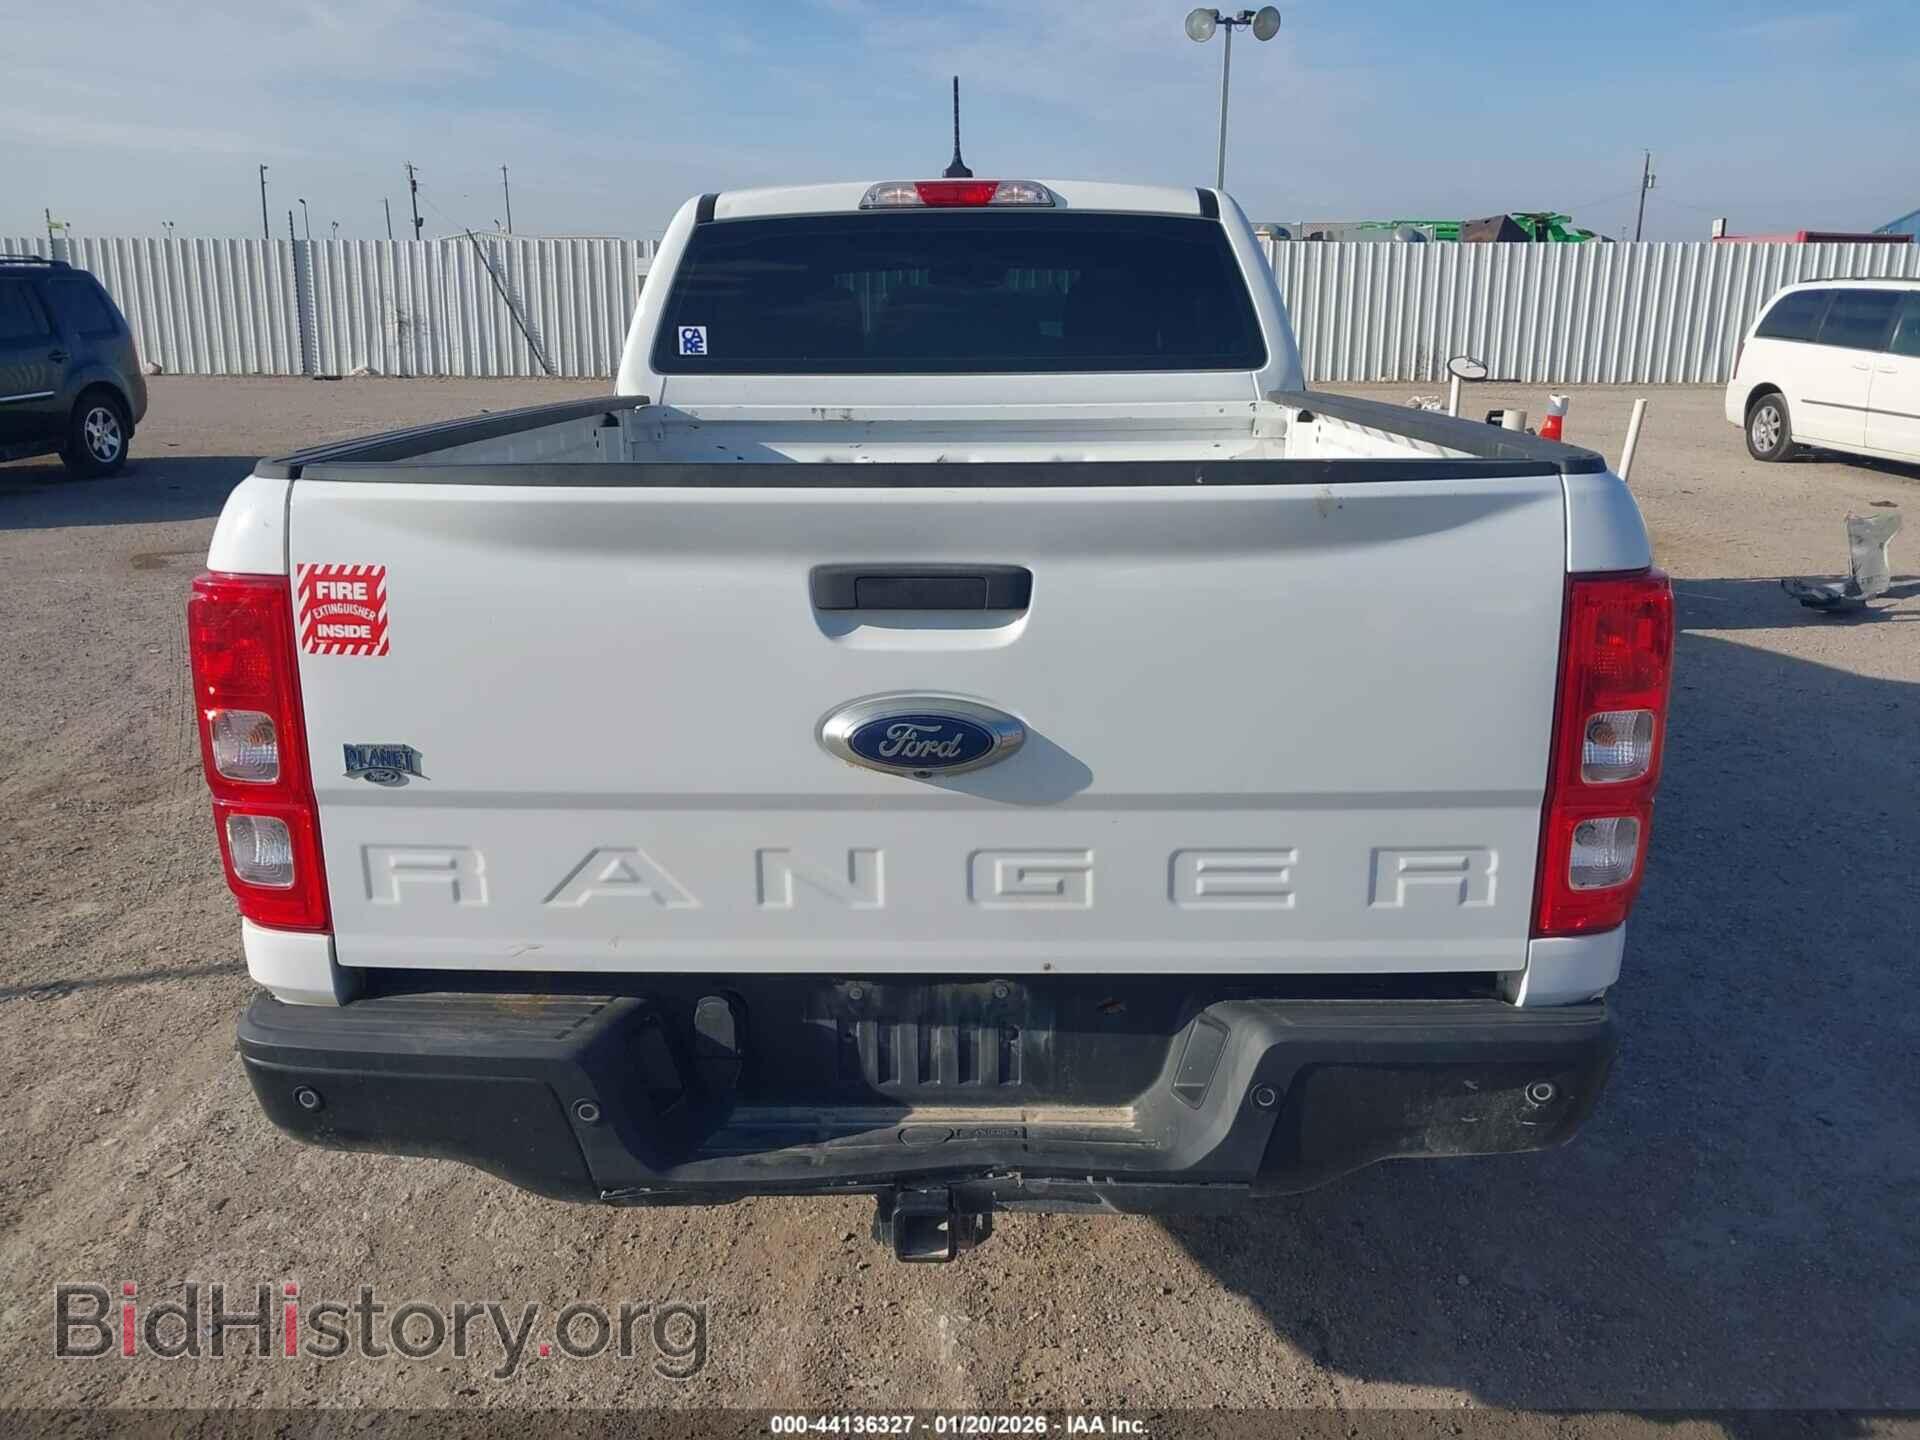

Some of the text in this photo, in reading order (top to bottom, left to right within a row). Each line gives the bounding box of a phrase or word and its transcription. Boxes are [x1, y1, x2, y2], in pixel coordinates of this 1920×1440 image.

[316, 581, 368, 600] FIRE
[312, 603, 376, 621] EXTINGUISHER
[317, 625, 371, 638] INSIDE
[879, 723, 963, 757] Ford
[361, 844, 1498, 911] RANGER
